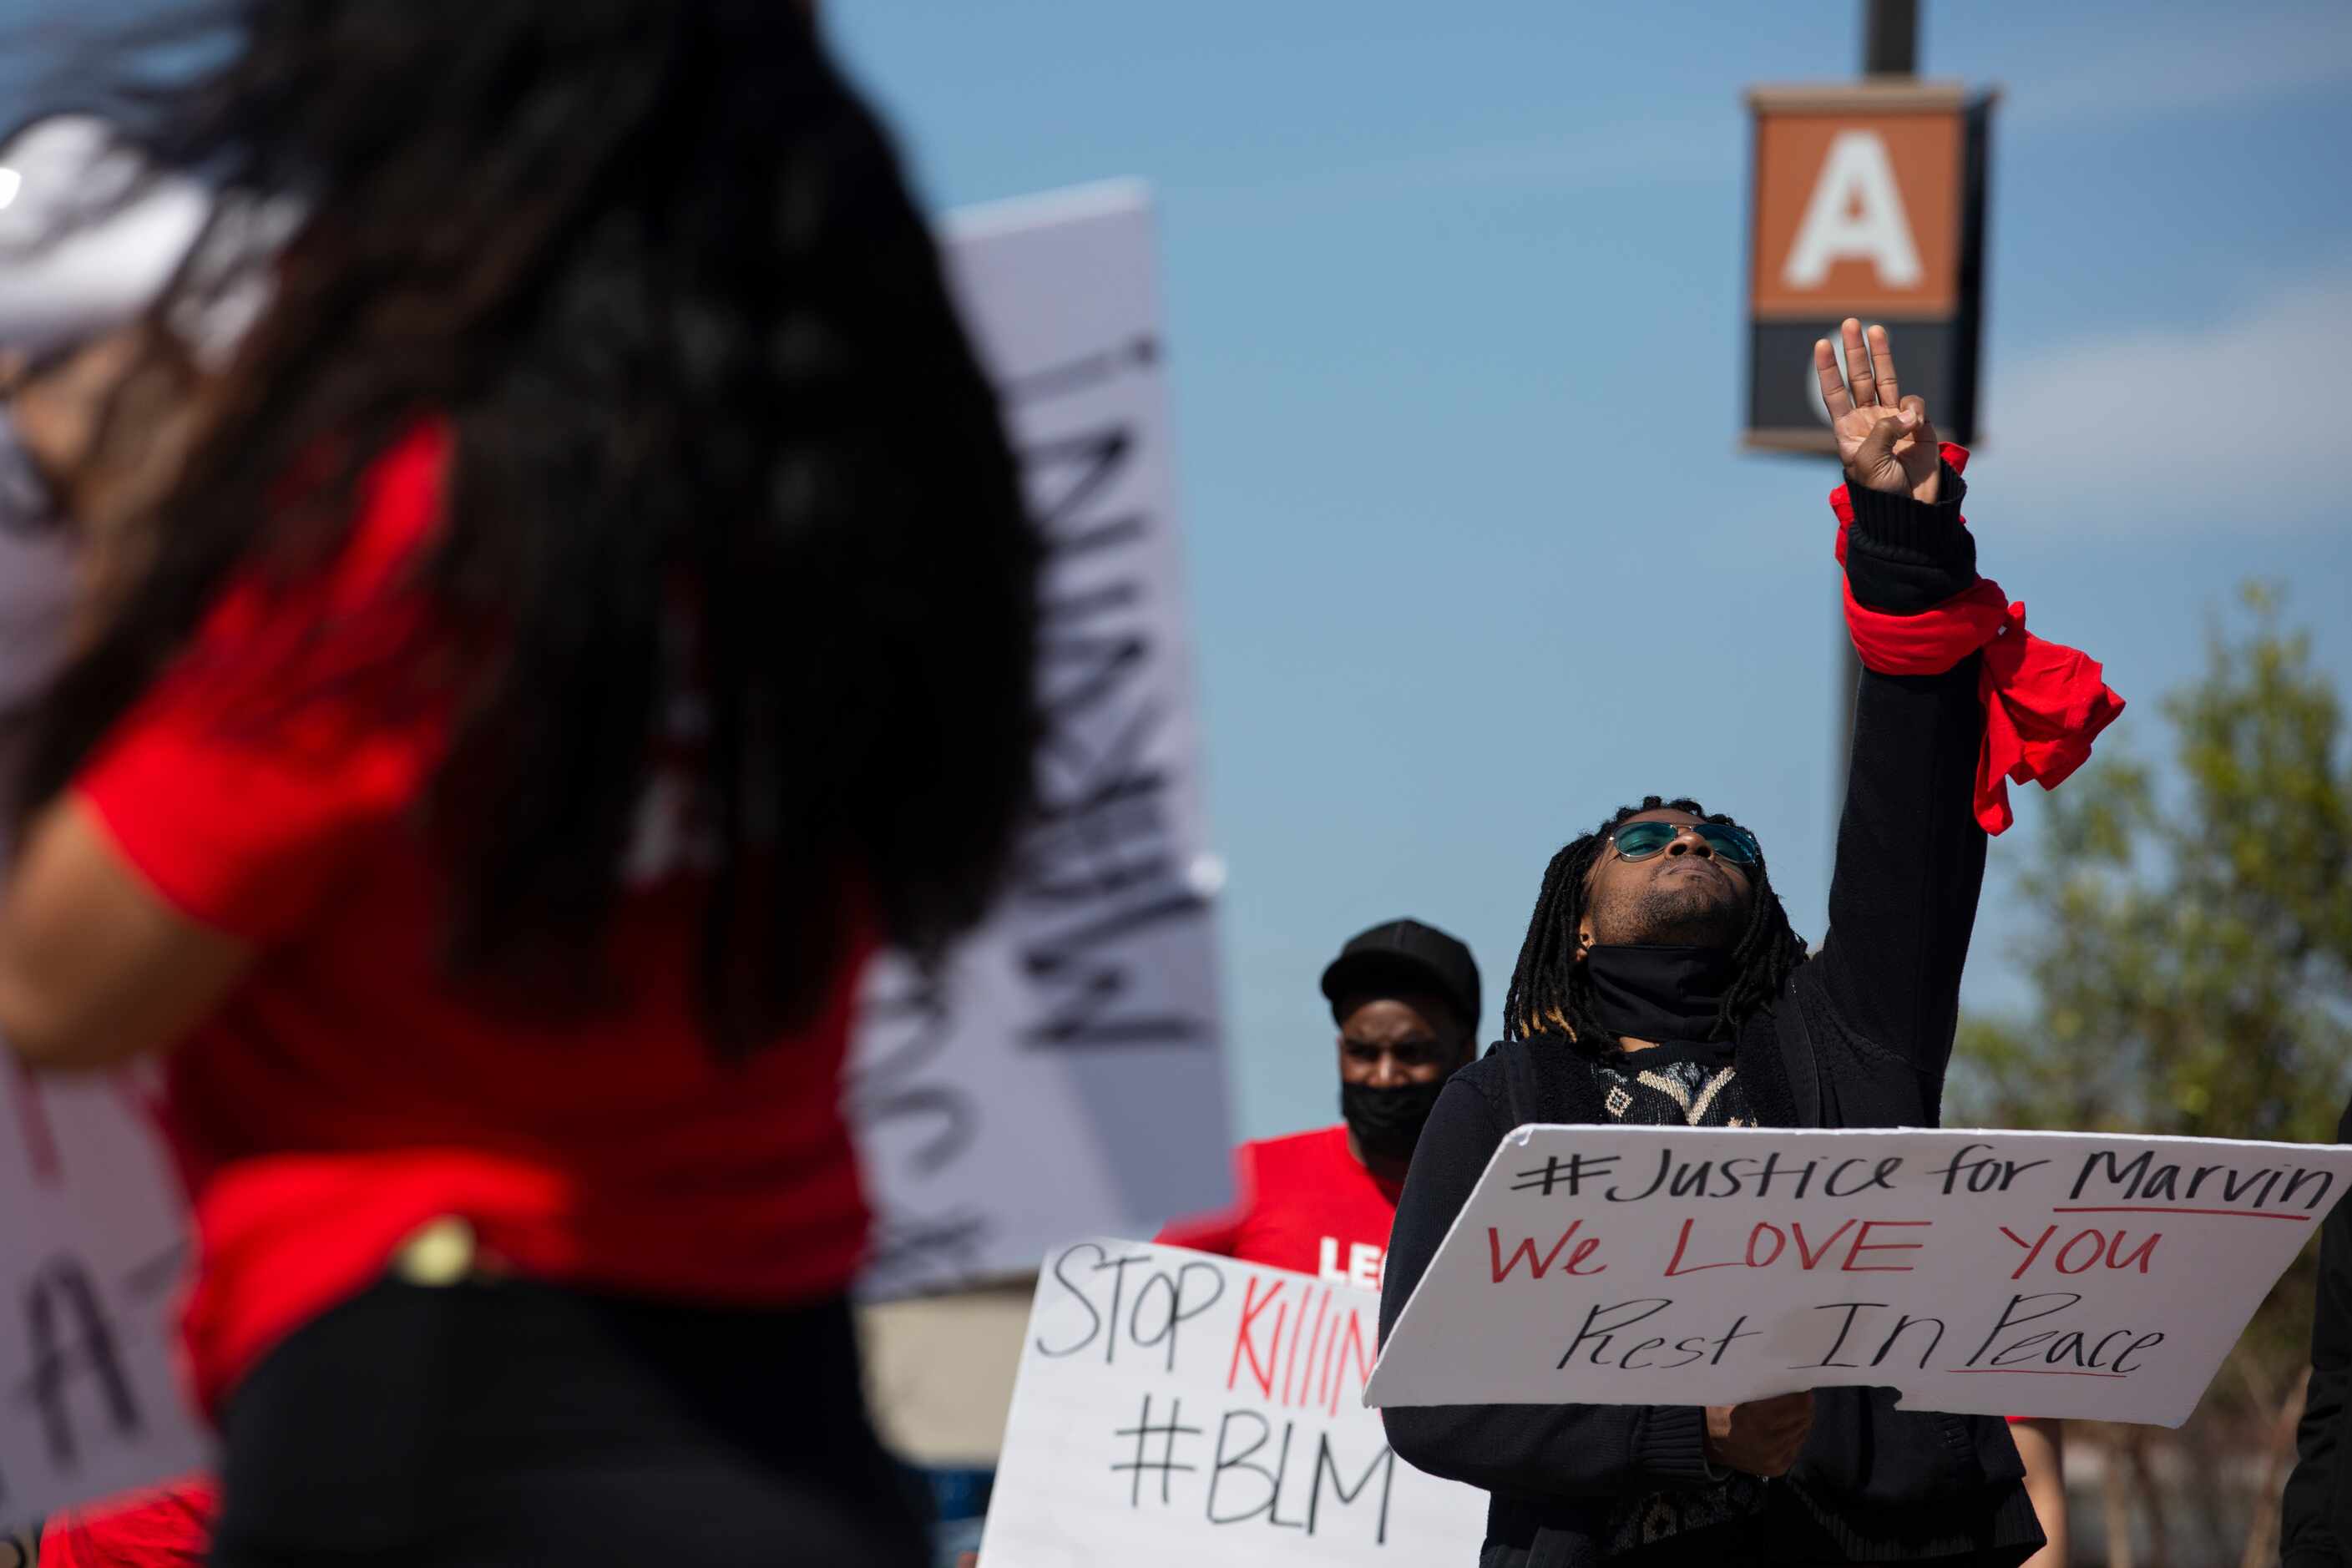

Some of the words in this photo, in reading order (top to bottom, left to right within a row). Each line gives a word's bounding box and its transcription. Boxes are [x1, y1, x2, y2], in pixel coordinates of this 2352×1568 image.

[1779, 129, 1924, 289] A
[1510, 1148, 1904, 1202] #Justice
[1925, 1143, 2052, 1196] for
[2068, 1150, 2334, 1211] Marvin
[1487, 1219, 1608, 1283] We
[1663, 1217, 1934, 1277] LOVE
[1998, 1224, 2163, 1281] YOU
[1036, 1242, 1226, 1373] STOP
[1555, 1297, 1764, 1370] Rest
[1788, 1302, 1945, 1371] In
[1964, 1292, 2166, 1374] Peace
[1110, 1393, 1396, 1546] #BLM
